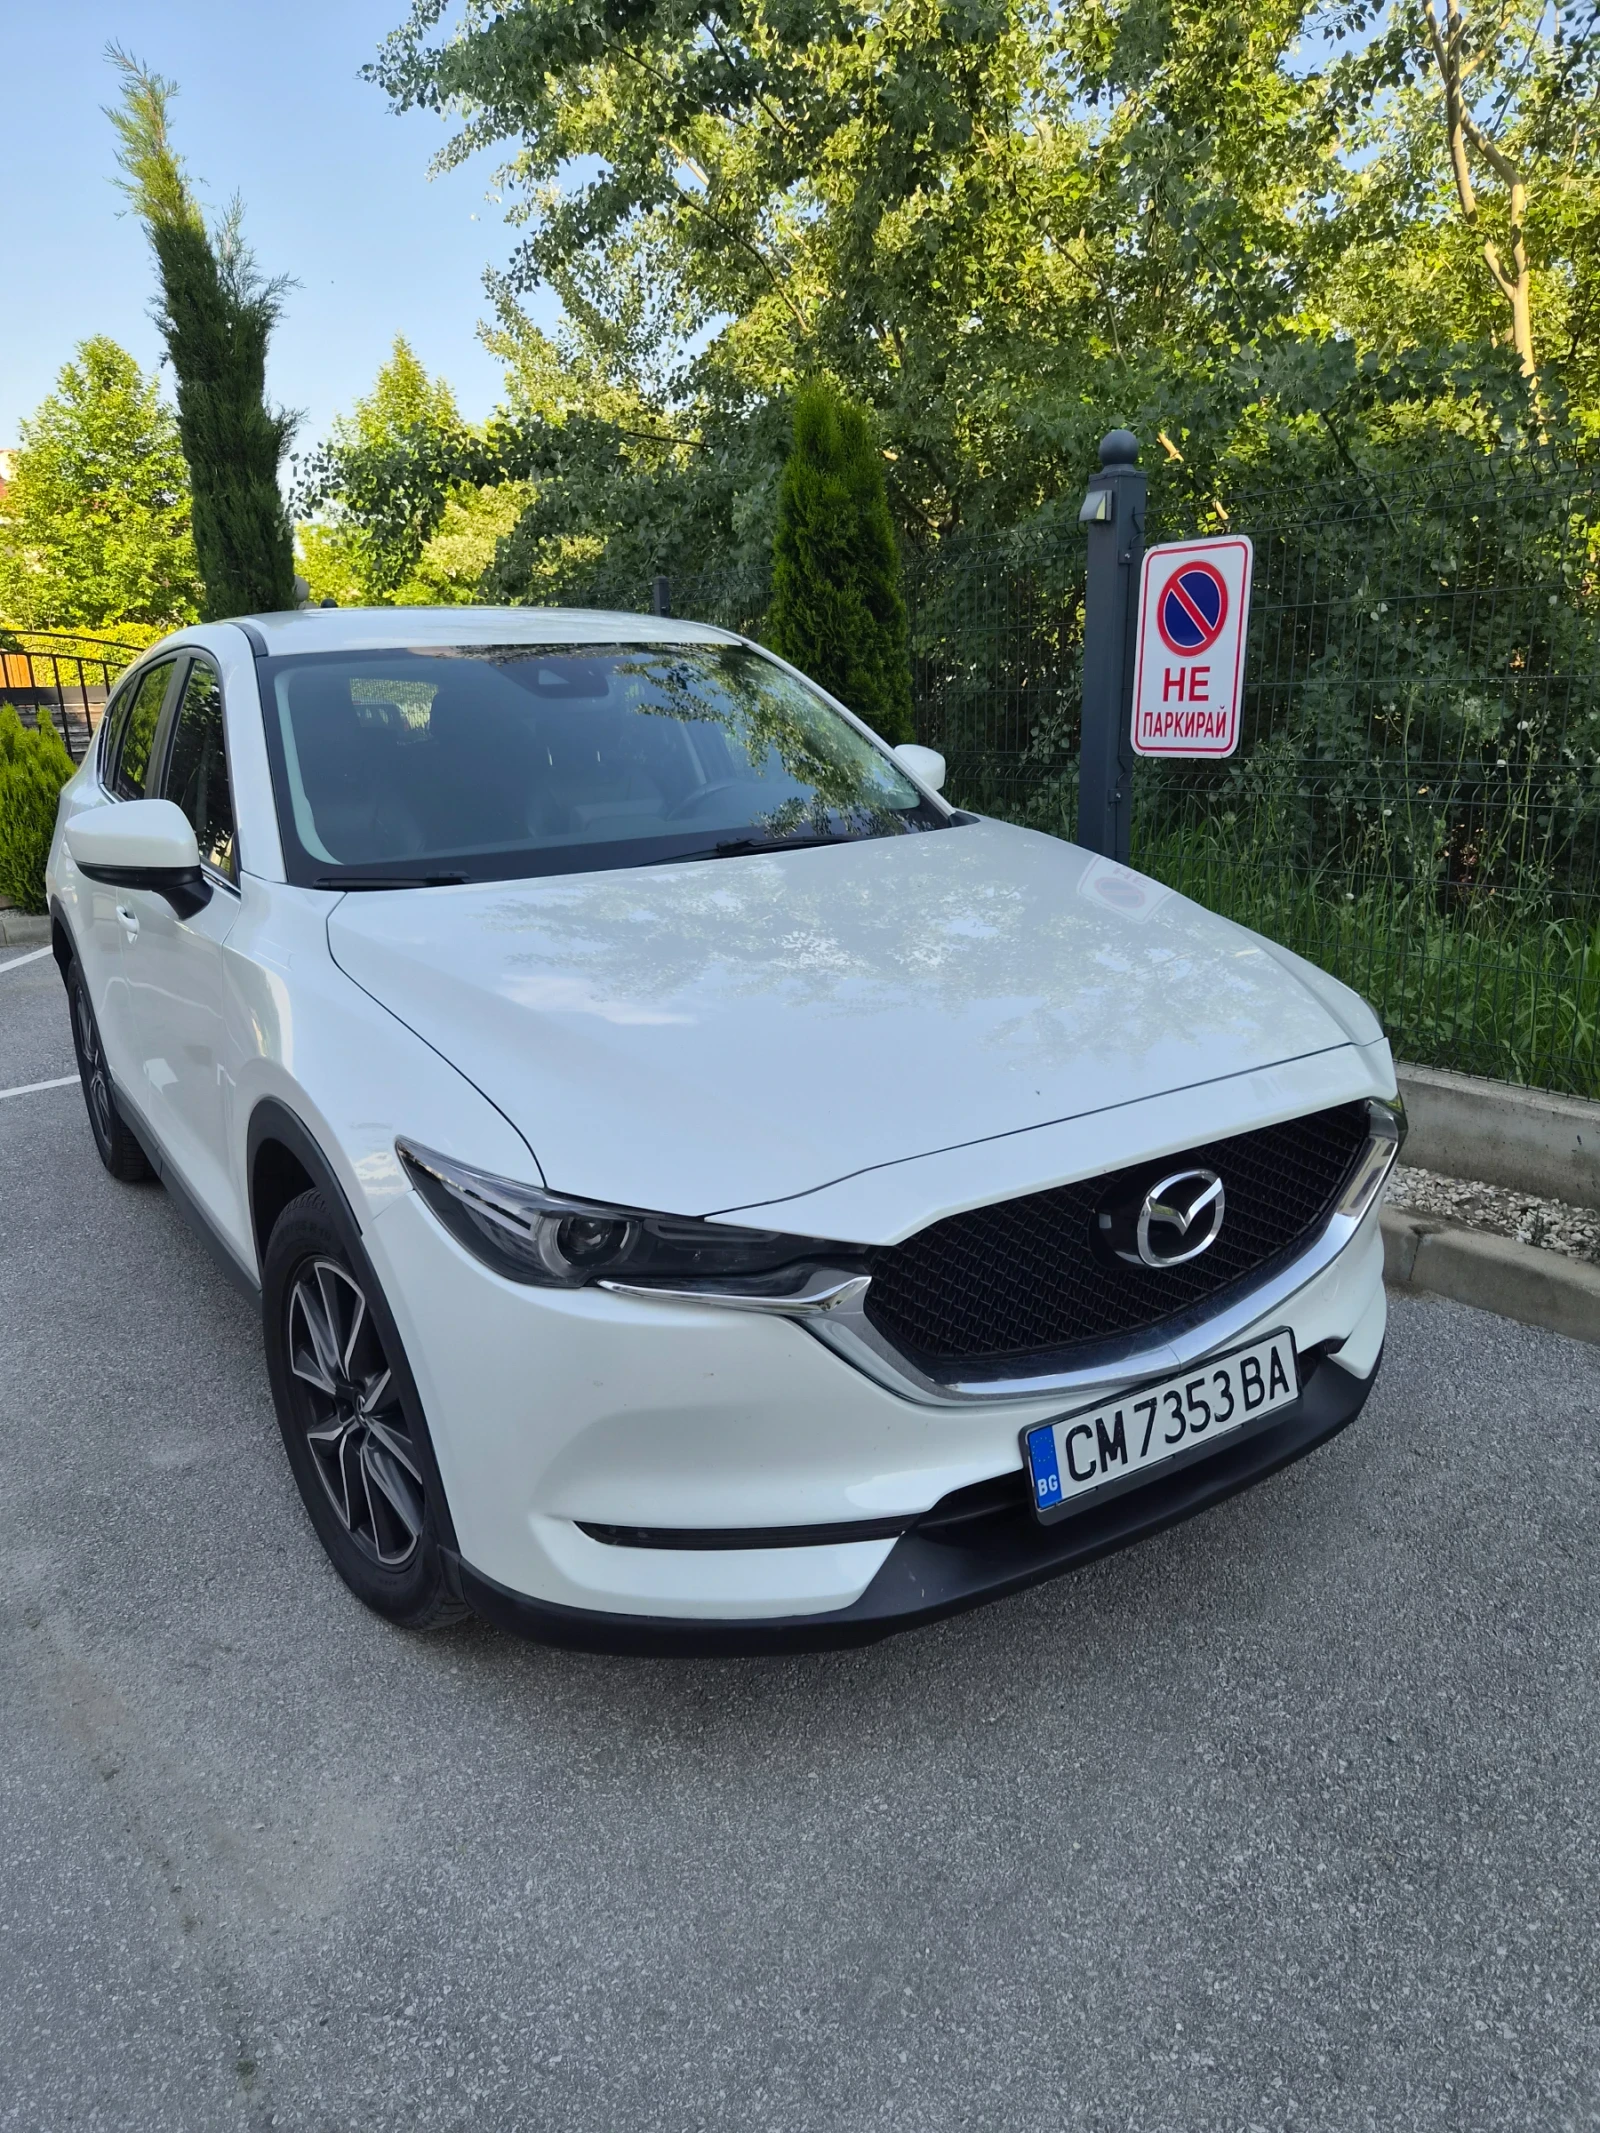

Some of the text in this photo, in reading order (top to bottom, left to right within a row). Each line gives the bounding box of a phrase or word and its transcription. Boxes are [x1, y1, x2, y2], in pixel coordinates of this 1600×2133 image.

[1162, 666, 1210, 701] НЕ
[1143, 706, 1227, 737] ПАРКИРАЙ
[1037, 1474, 1059, 1497] BG
